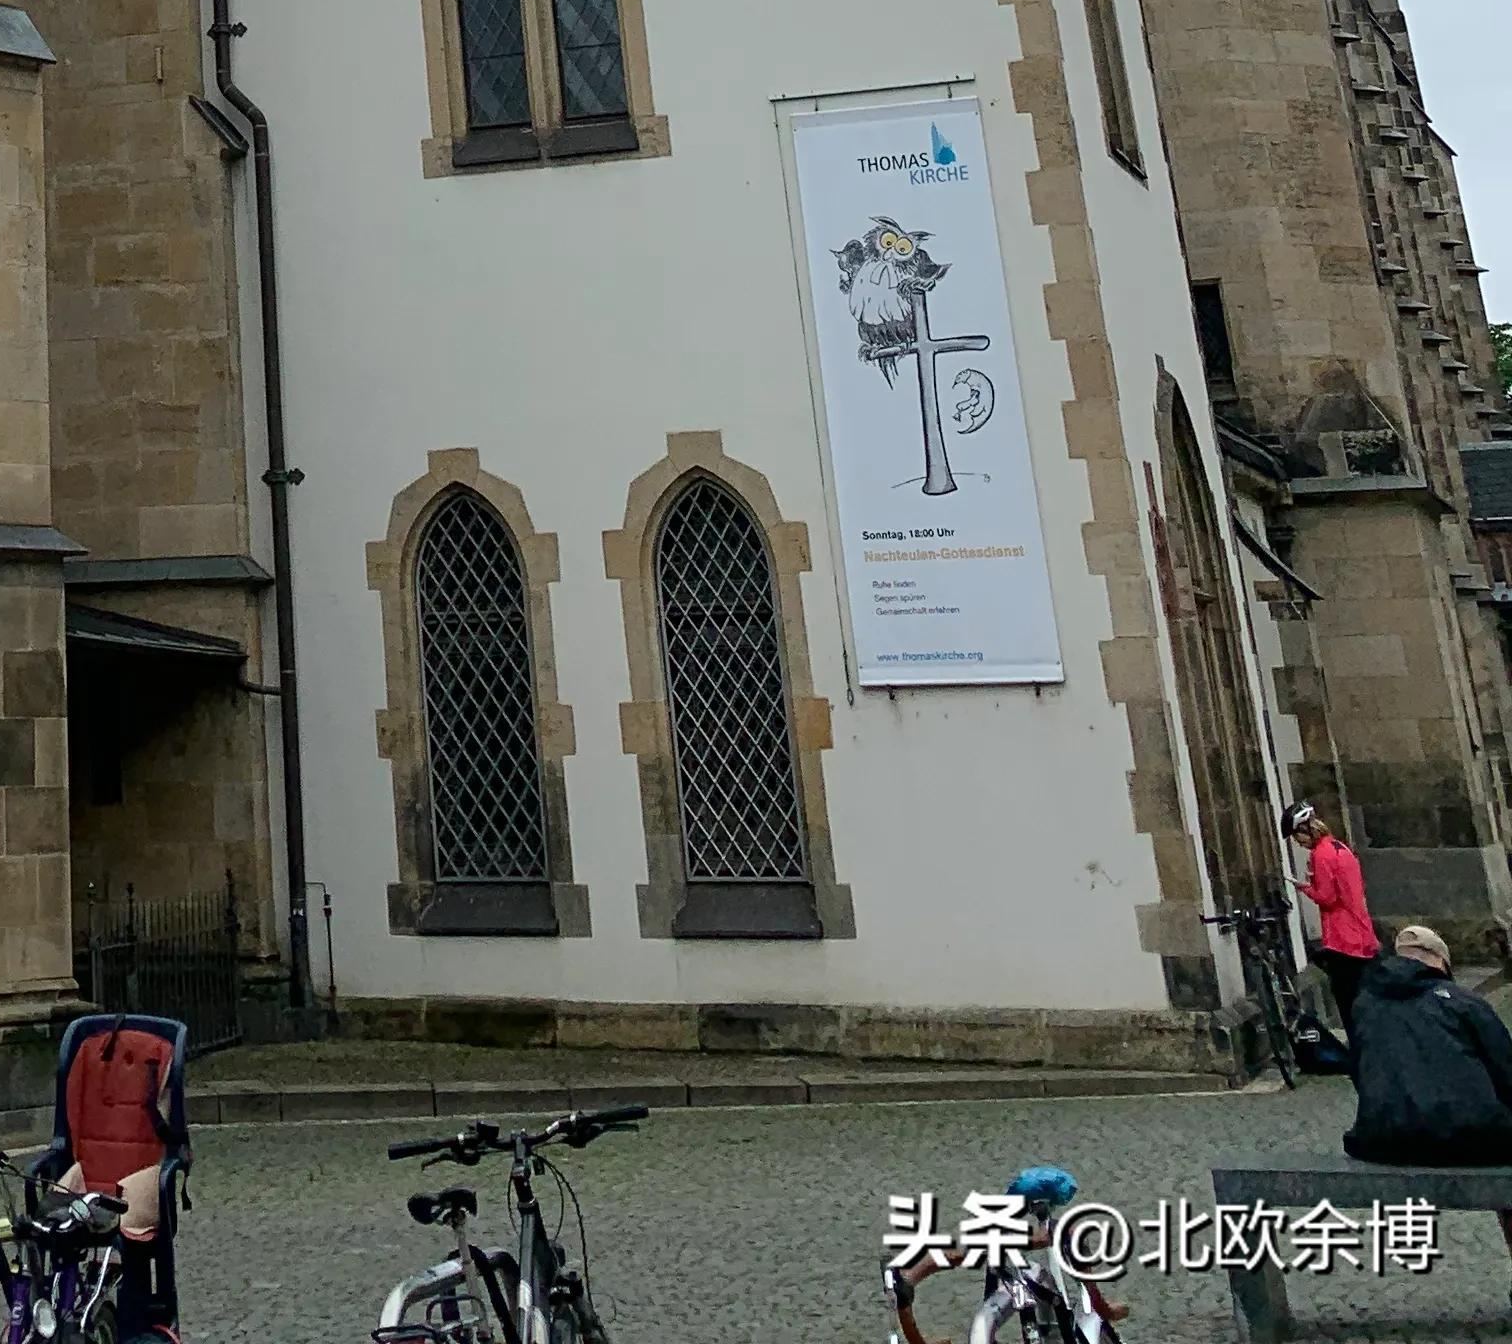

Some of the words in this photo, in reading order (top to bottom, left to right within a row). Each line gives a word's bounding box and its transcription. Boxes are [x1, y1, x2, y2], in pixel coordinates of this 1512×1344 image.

[857, 152, 930, 173] THOMAS
[909, 165, 969, 185] KIRCHE
[862, 530, 906, 541] Sonntag,
[937, 527, 955, 537] Uhr
